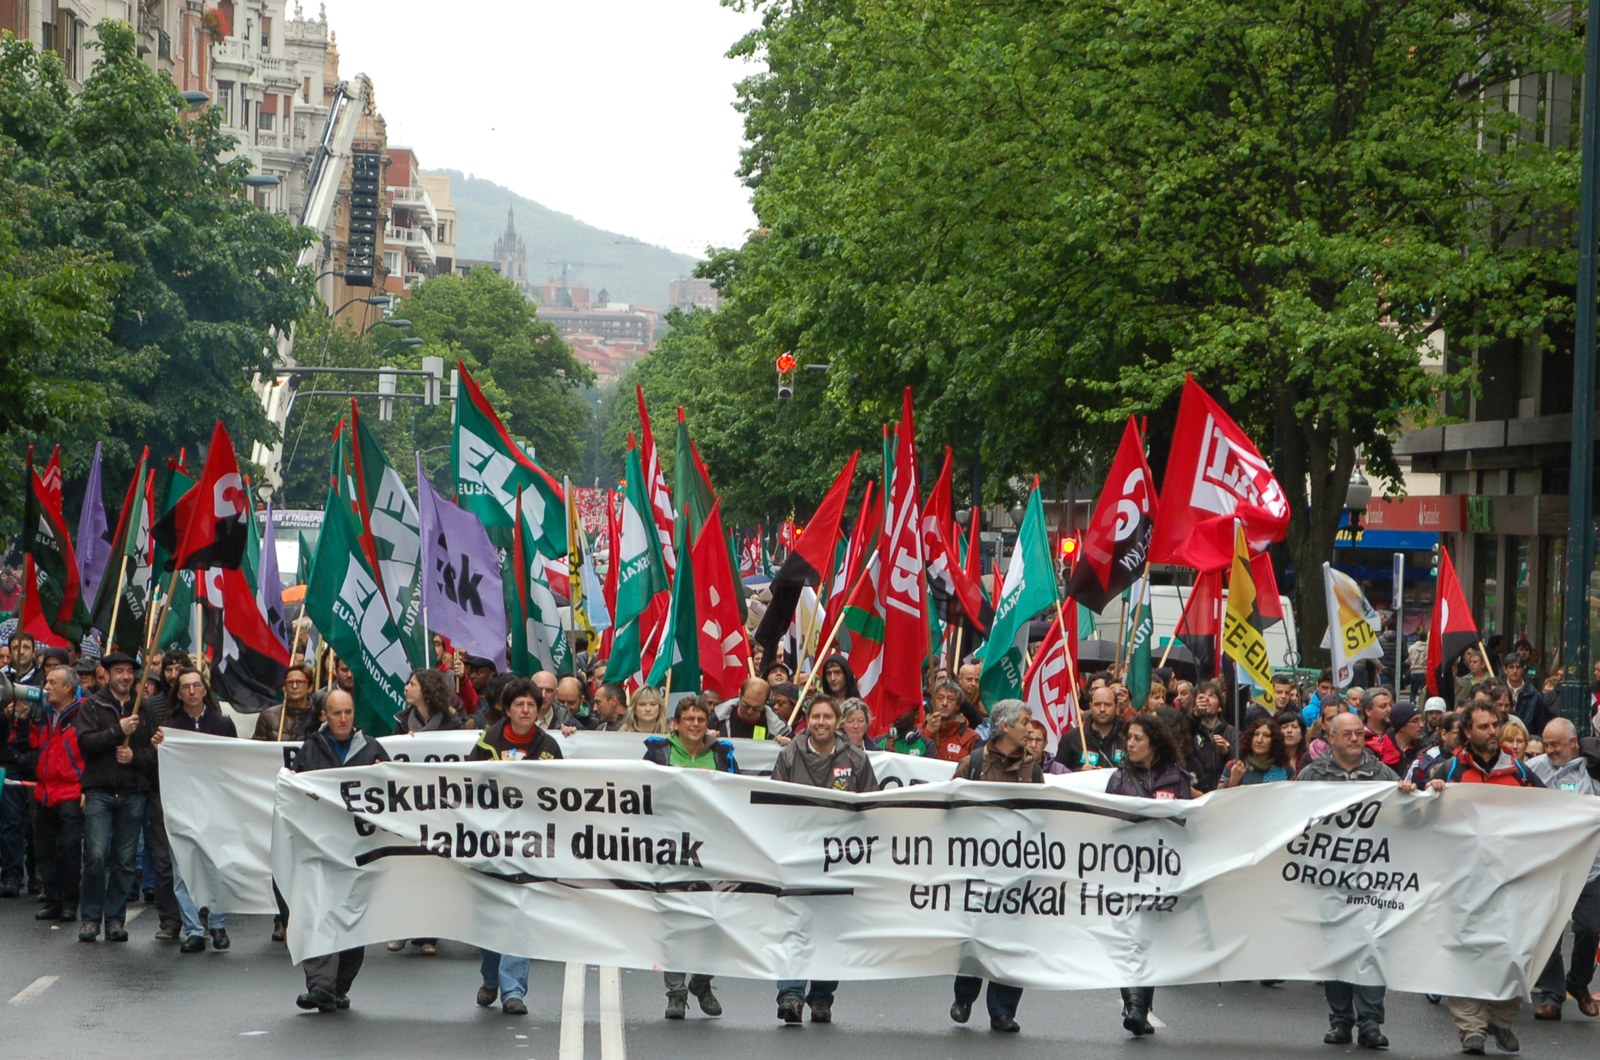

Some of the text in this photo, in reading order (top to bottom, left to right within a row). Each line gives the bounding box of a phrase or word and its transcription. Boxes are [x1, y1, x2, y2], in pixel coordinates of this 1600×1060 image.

[341, 776, 653, 815] Eskubide sozial
[420, 823, 555, 858] laboral
[571, 825, 704, 868] duinak
[824, 831, 1181, 882] por un modelo propio
[1287, 833, 1390, 864] GREBA
[1282, 862, 1419, 892] OROKORRA
[910, 879, 1178, 915] en Euskal Herria
[1346, 895, 1404, 910] #m30greba
